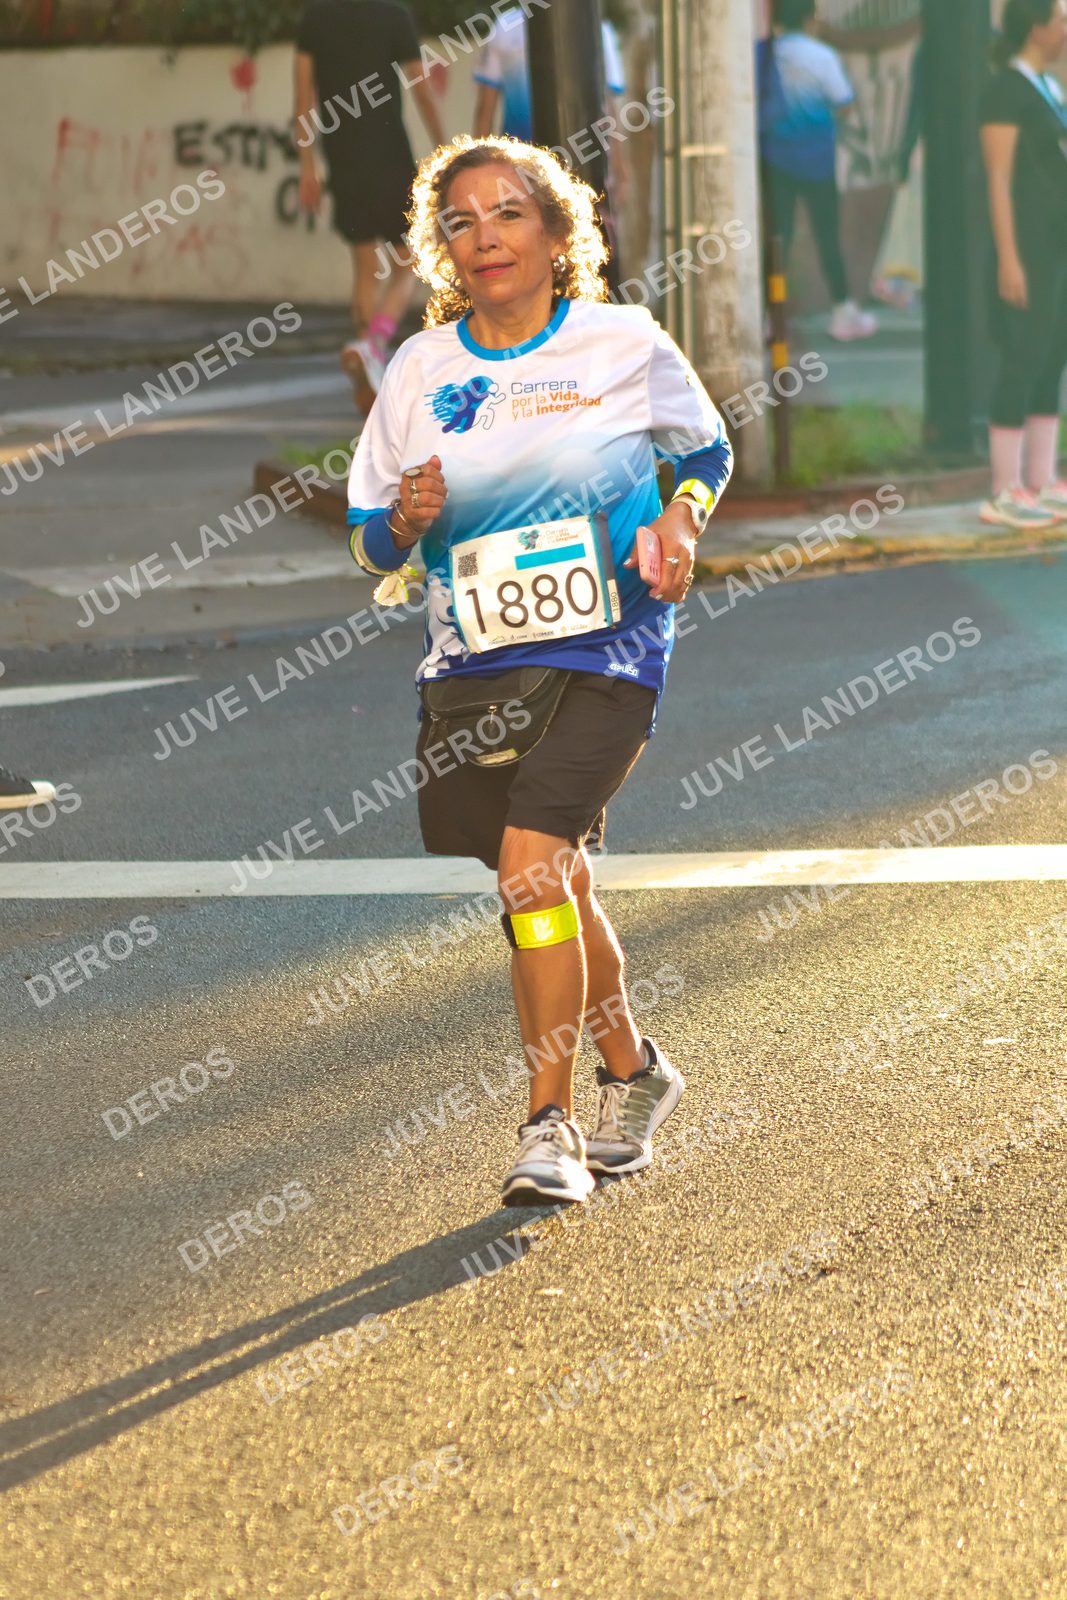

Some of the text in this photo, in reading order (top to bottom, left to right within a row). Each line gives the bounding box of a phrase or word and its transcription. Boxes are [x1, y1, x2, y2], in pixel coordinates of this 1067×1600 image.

[511, 380, 577, 395] Carrera
[512, 390, 579, 410] por la Vida
[512, 396, 601, 421] y la Integridad
[465, 566, 598, 635] 1880
